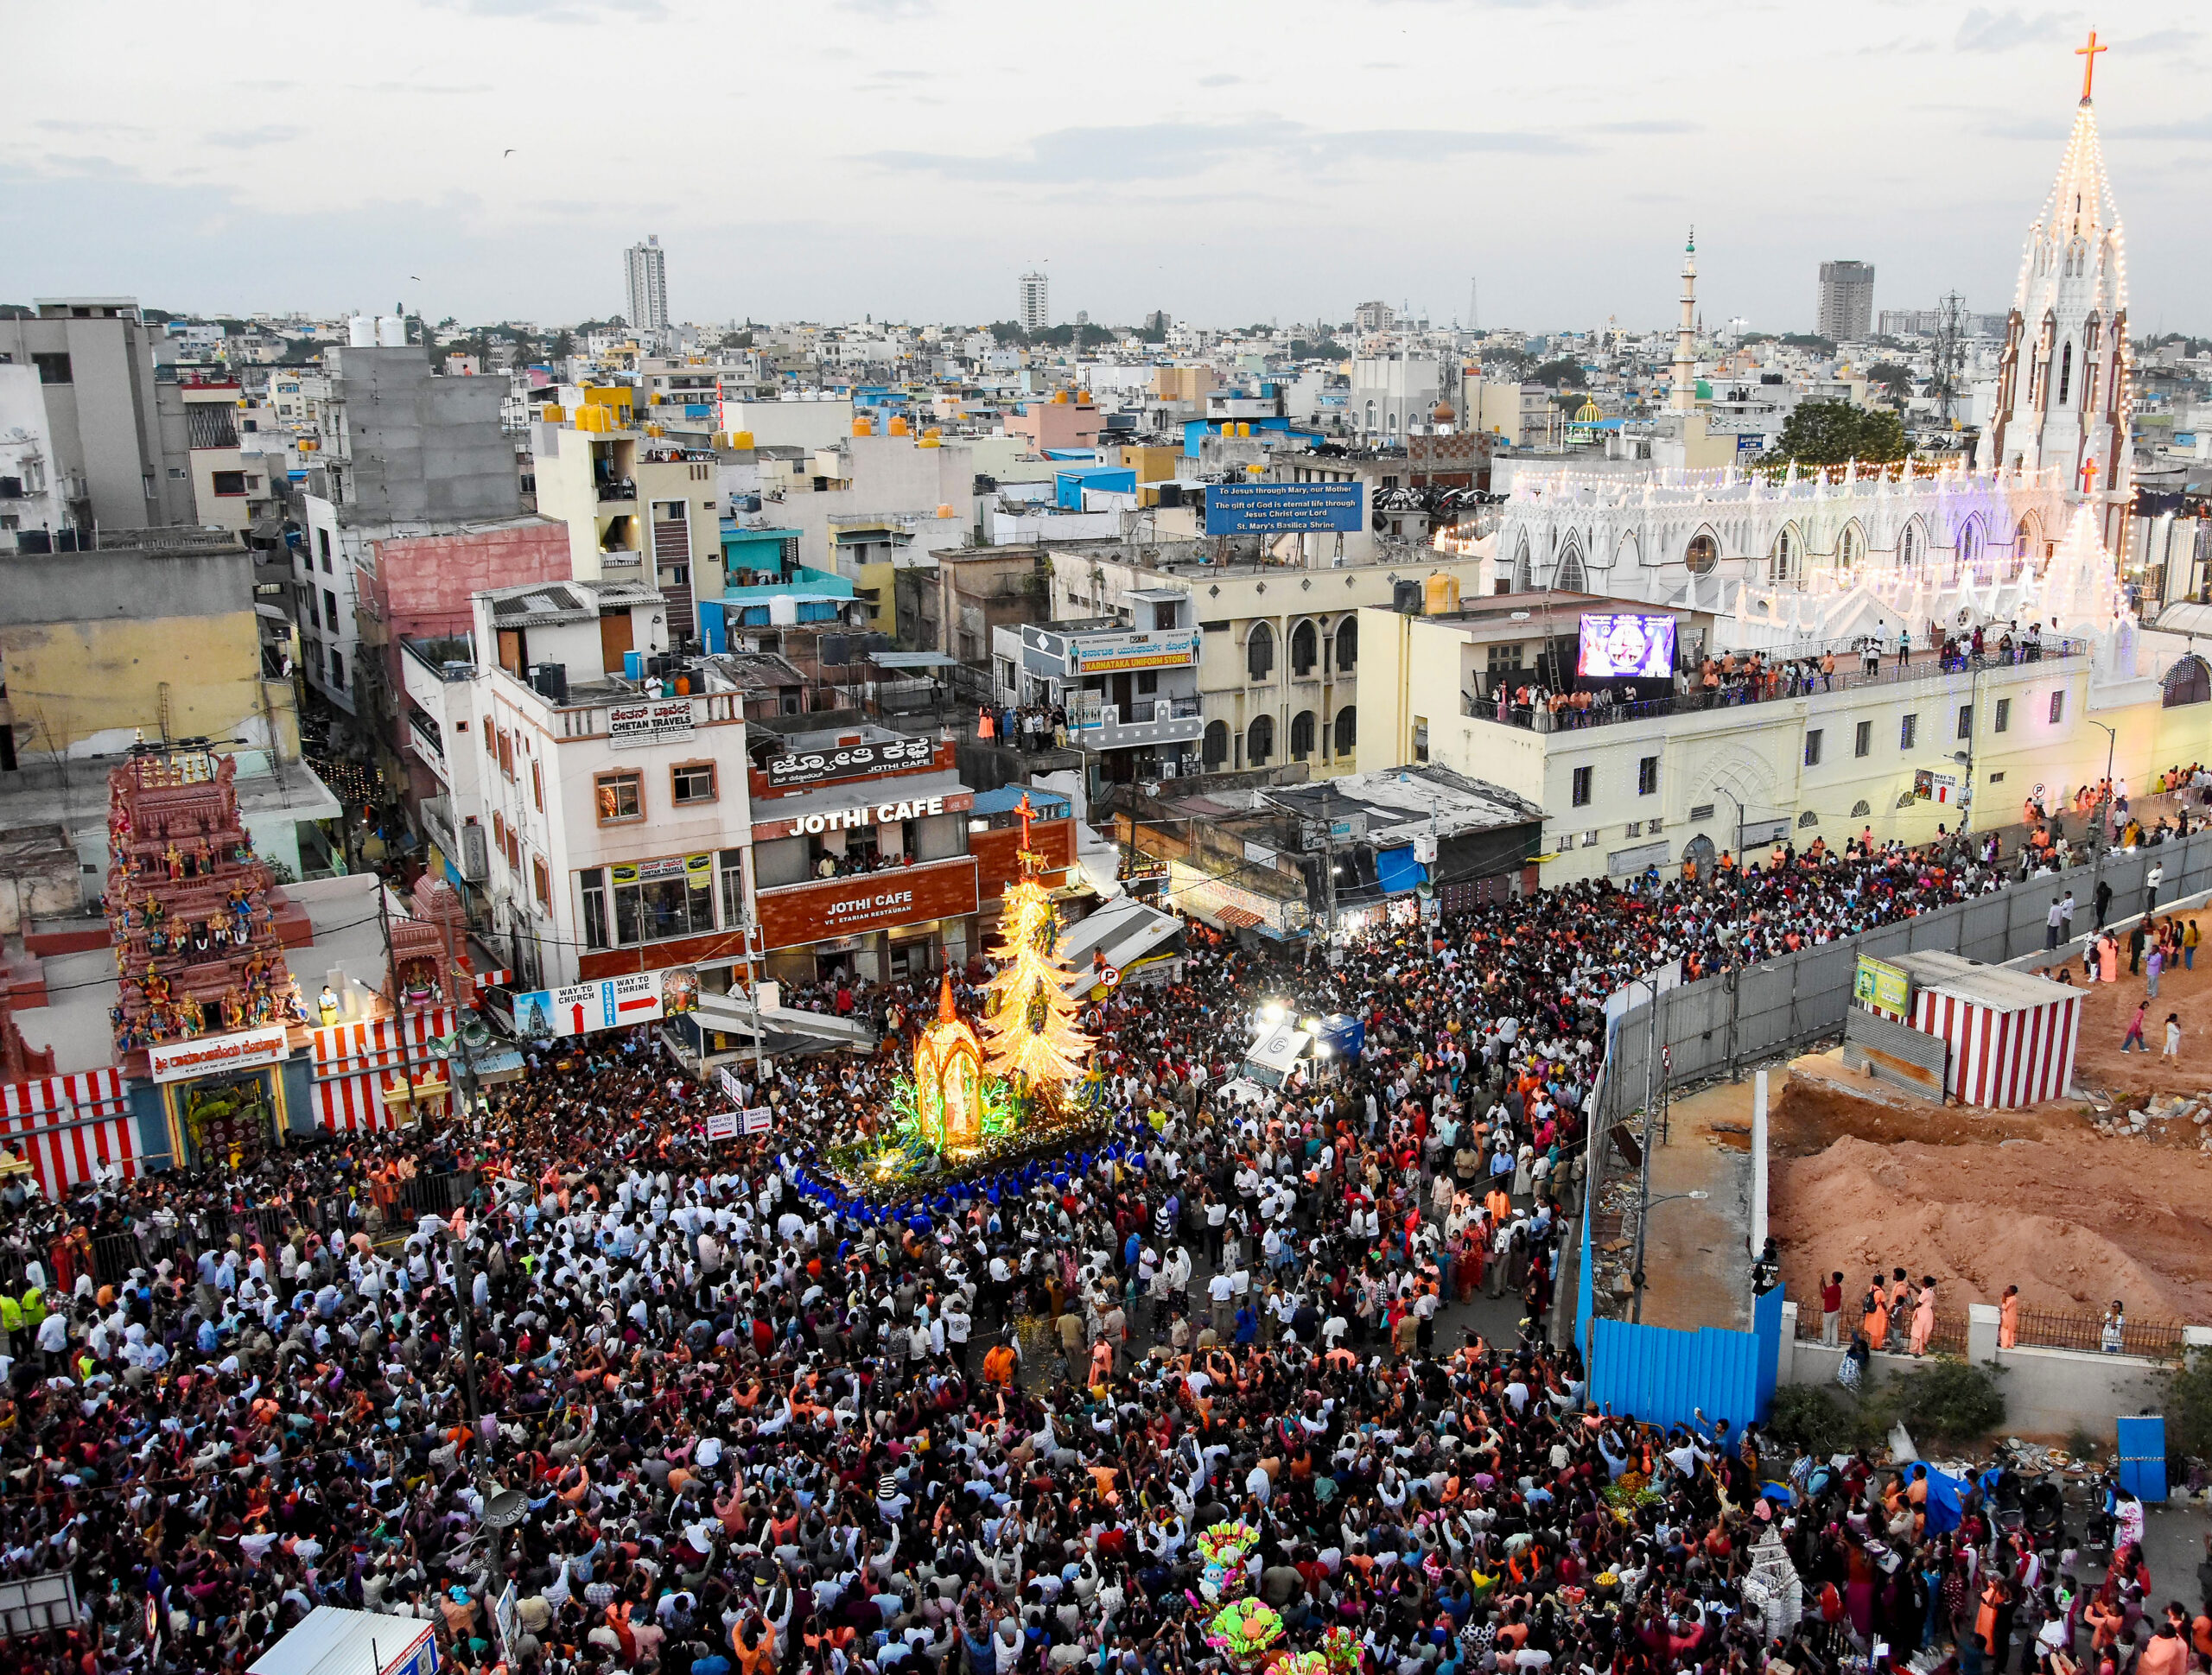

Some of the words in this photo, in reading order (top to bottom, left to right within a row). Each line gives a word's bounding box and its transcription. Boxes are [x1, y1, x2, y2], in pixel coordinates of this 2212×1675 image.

[1255, 486, 1287, 495] through
[1287, 486, 1309, 495] Mary,
[1231, 501, 1245, 510] gift
[1325, 499, 1356, 508] through
[1276, 521, 1307, 530] Basilica
[1081, 648, 1114, 658] ಕರ್ನಾಟಕ
[1085, 659, 1130, 670] KARNATAKA
[1131, 657, 1163, 668] UNIFORM
[1164, 654, 1186, 665] STORE
[611, 707, 648, 721] ಚೇತನ್
[612, 720, 649, 731] CHETAN
[652, 715, 691, 729] TRAVELS
[772, 748, 874, 775] ಜ್ಯೋತಿ
[868, 763, 899, 772] JOTHI
[902, 758, 931, 768] CAFE
[1934, 778, 1955, 787] SHRINE
[789, 808, 868, 836] JOTHI
[876, 796, 944, 823] CAFE
[827, 898, 871, 916] JOTHI
[875, 891, 912, 906] CAFE
[870, 905, 912, 918] RESTAURAN
[617, 977, 637, 987] WAY
[638, 975, 649, 984] TO
[559, 987, 578, 996] WAY
[617, 982, 650, 994] SHRINE
[558, 993, 594, 1005] CHURCH
[605, 982, 614, 1026] AVEMARIA
[155, 1056, 168, 1075] ಶ್ರೀ
[397, 1654, 405, 1665] CITY
[420, 1626, 433, 1641] POLICE
